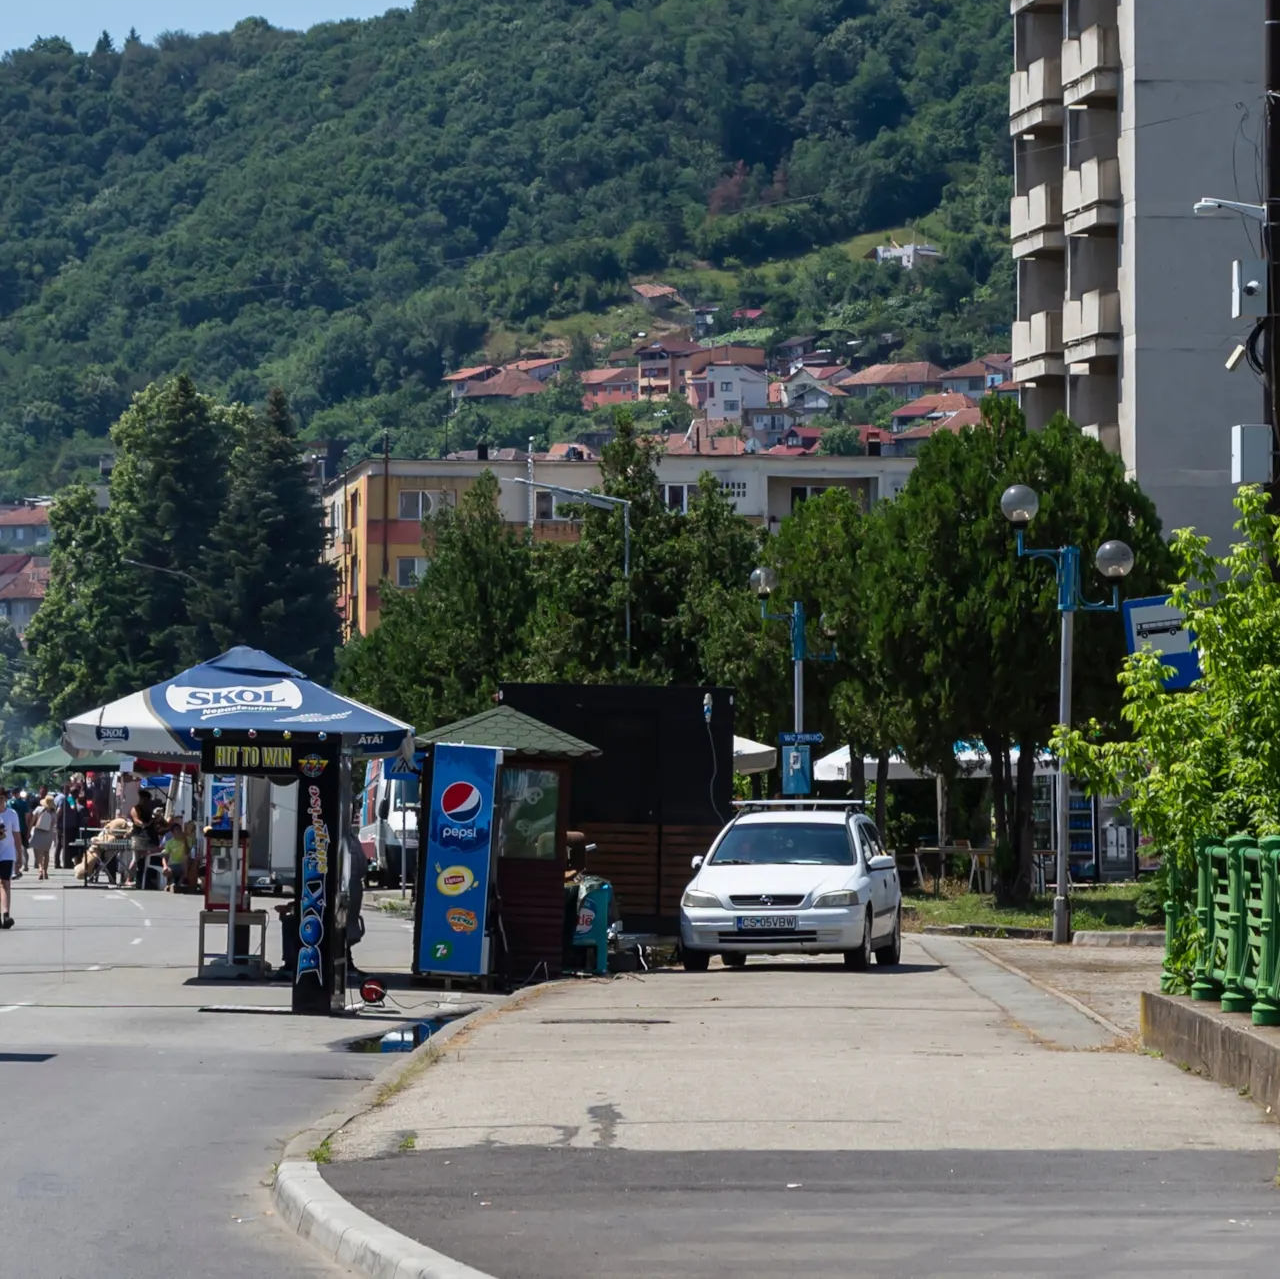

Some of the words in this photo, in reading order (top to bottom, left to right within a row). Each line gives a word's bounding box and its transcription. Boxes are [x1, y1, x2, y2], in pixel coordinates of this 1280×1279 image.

[186, 689, 286, 707] SKOL
[100, 728, 126, 738] SKOL
[784, 734, 796, 742] WC
[797, 733, 820, 742] PUBLIC
[215, 745, 240, 768] HIT
[242, 746, 261, 768] TO
[263, 747, 292, 769] WIN
[298, 758, 329, 773] 777
[442, 826, 477, 839] pepsi
[444, 875, 465, 885] Lipton
[743, 917, 757, 927] CS
